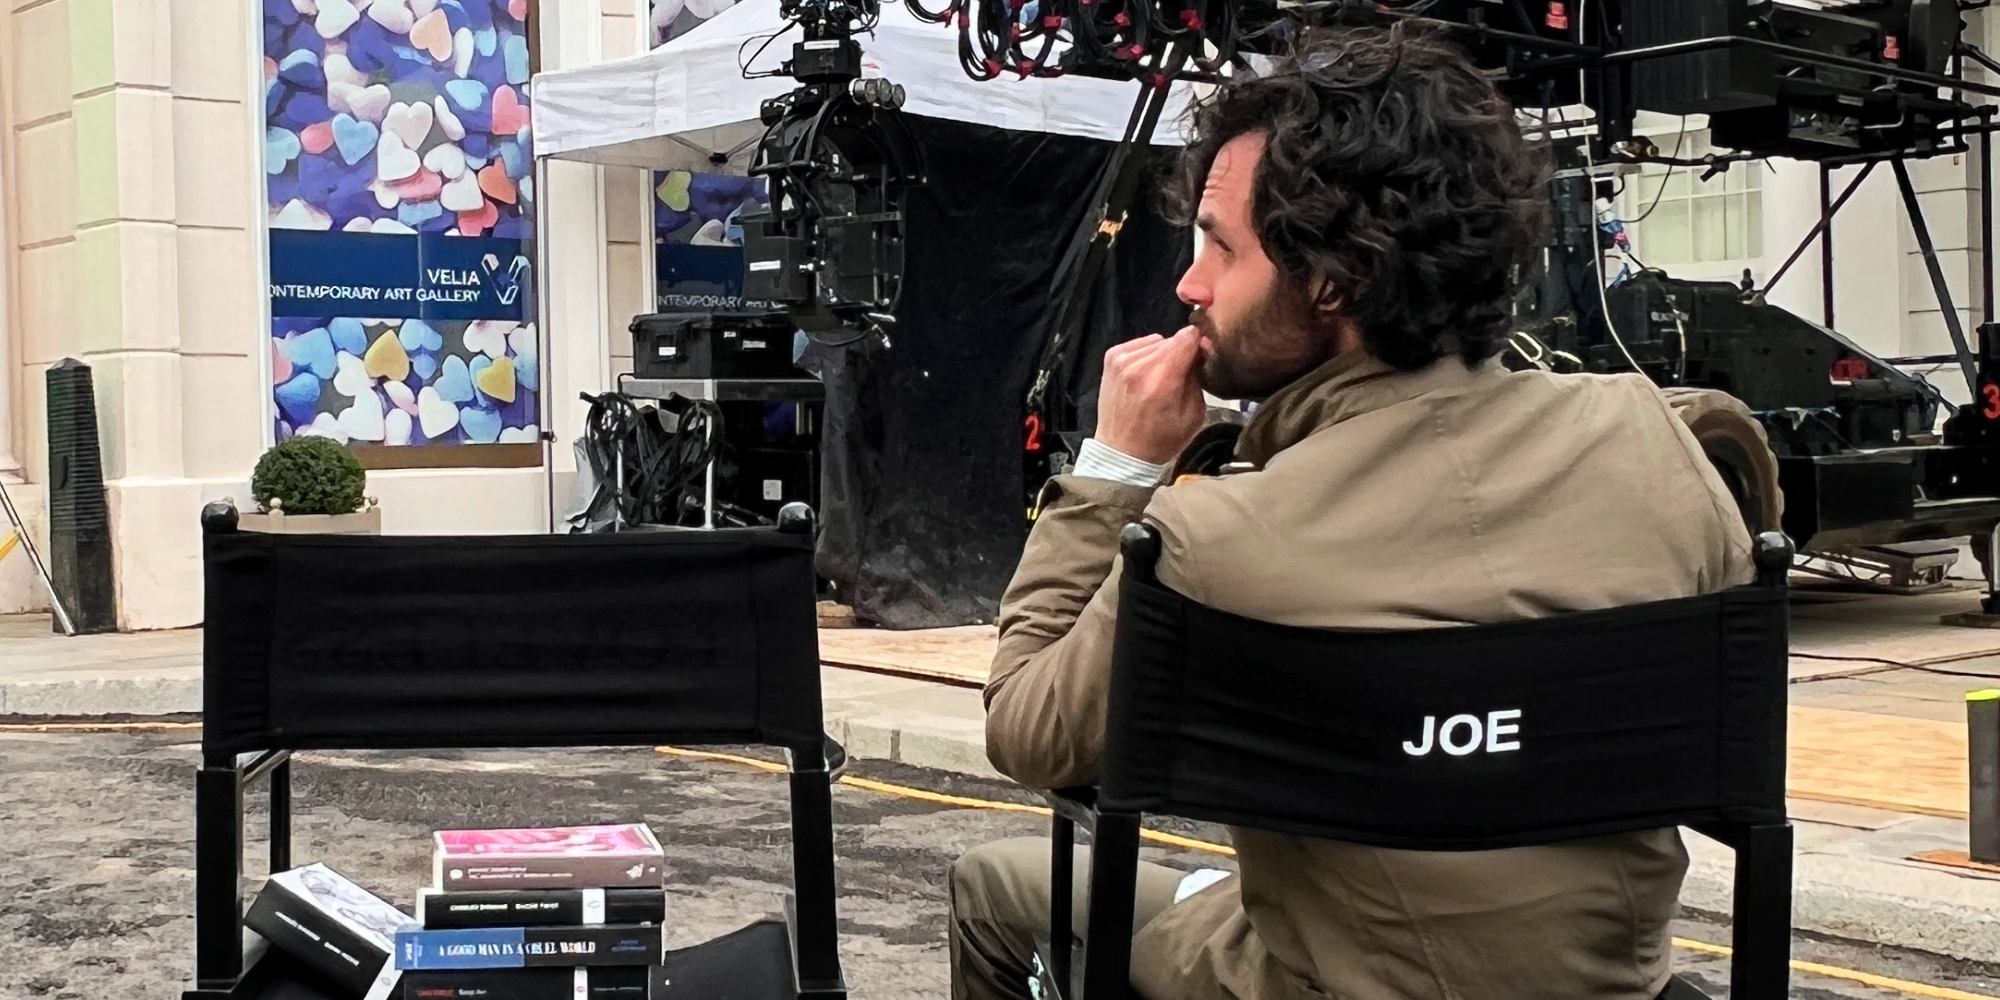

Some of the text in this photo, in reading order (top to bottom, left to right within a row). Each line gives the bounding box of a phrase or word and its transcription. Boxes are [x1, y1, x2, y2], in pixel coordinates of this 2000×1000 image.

[427, 268, 481, 286] VELIA
[268, 284, 480, 302] ONTEMPORARY ART GALLERY
[1983, 383, 2000, 419] 3
[1025, 414, 1040, 450] 2
[1402, 709, 1522, 756] JOE
[478, 943, 500, 956] MAN
[560, 940, 597, 955] WORLD
